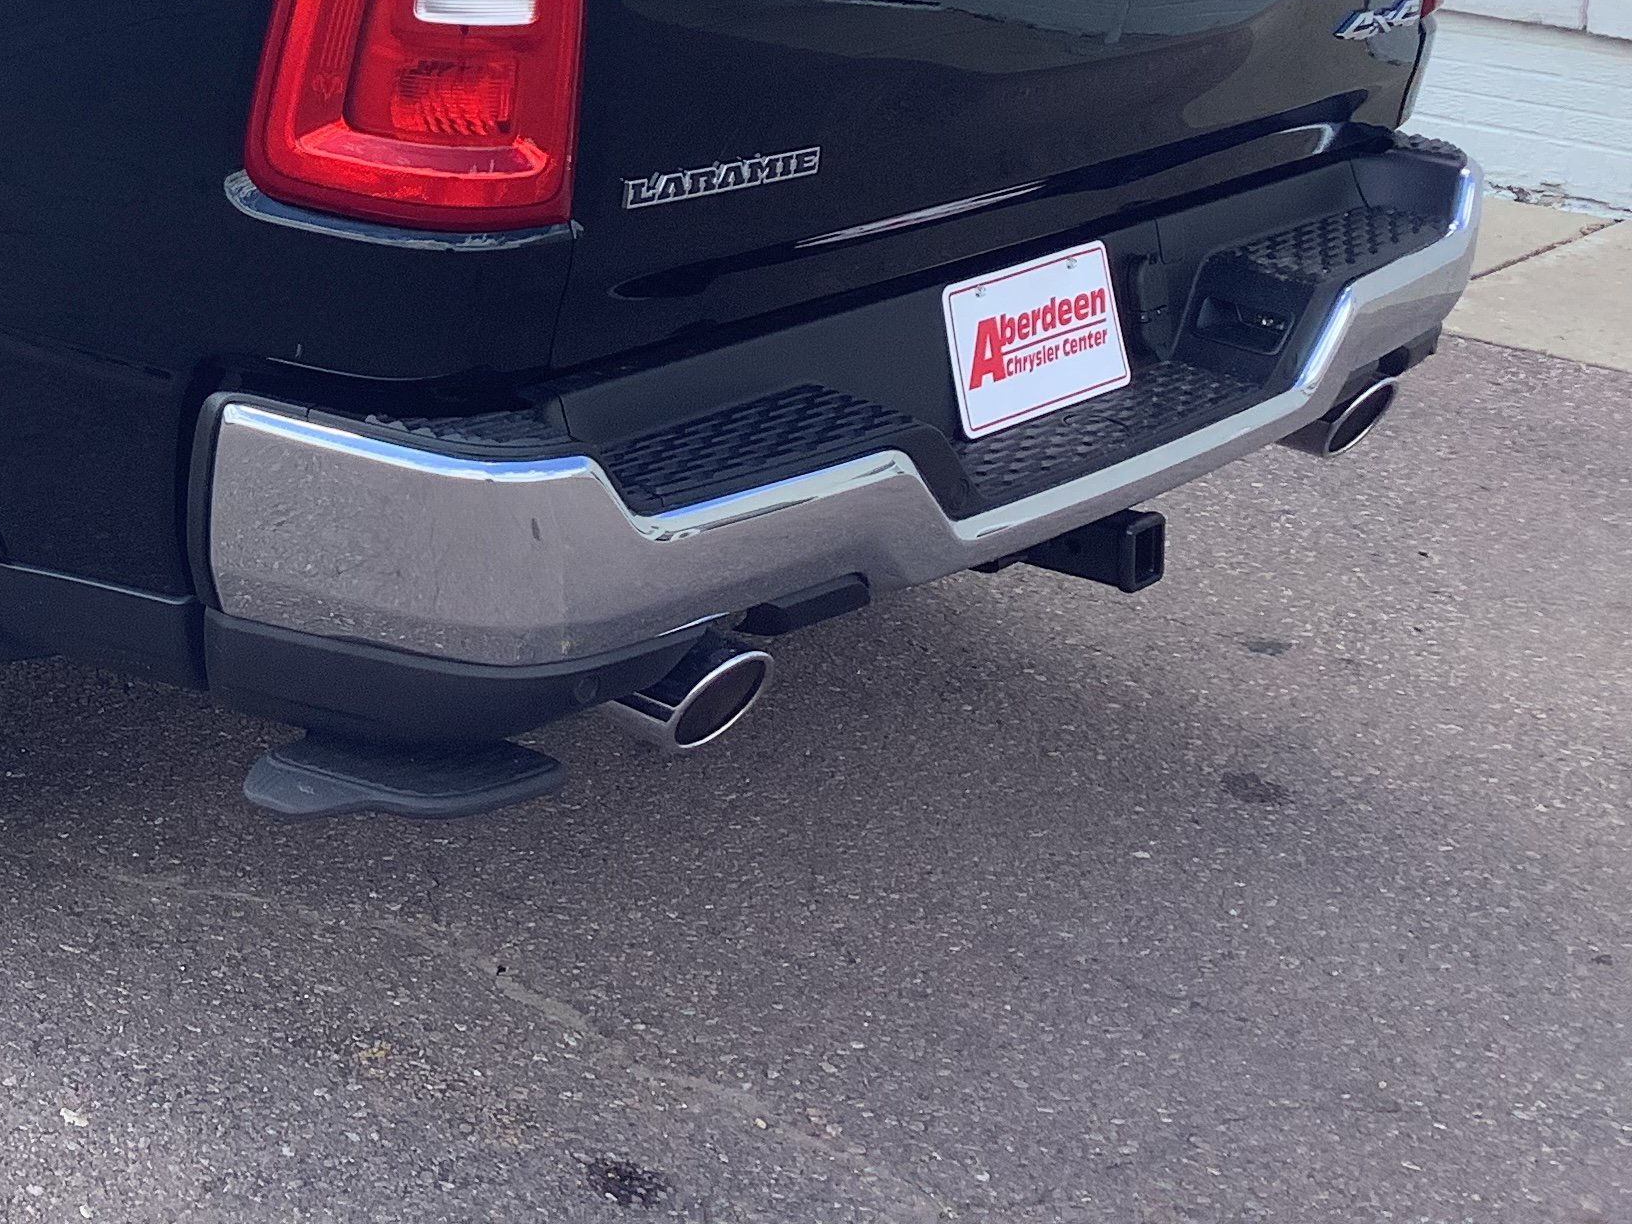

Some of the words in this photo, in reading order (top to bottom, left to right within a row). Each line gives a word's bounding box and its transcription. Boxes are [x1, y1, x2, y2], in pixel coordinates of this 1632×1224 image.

[621, 146, 821, 209] LARAMIE
[969, 287, 1106, 391] Aberdeen
[1005, 344, 1061, 377] Chrysler
[1062, 328, 1108, 357] Center
